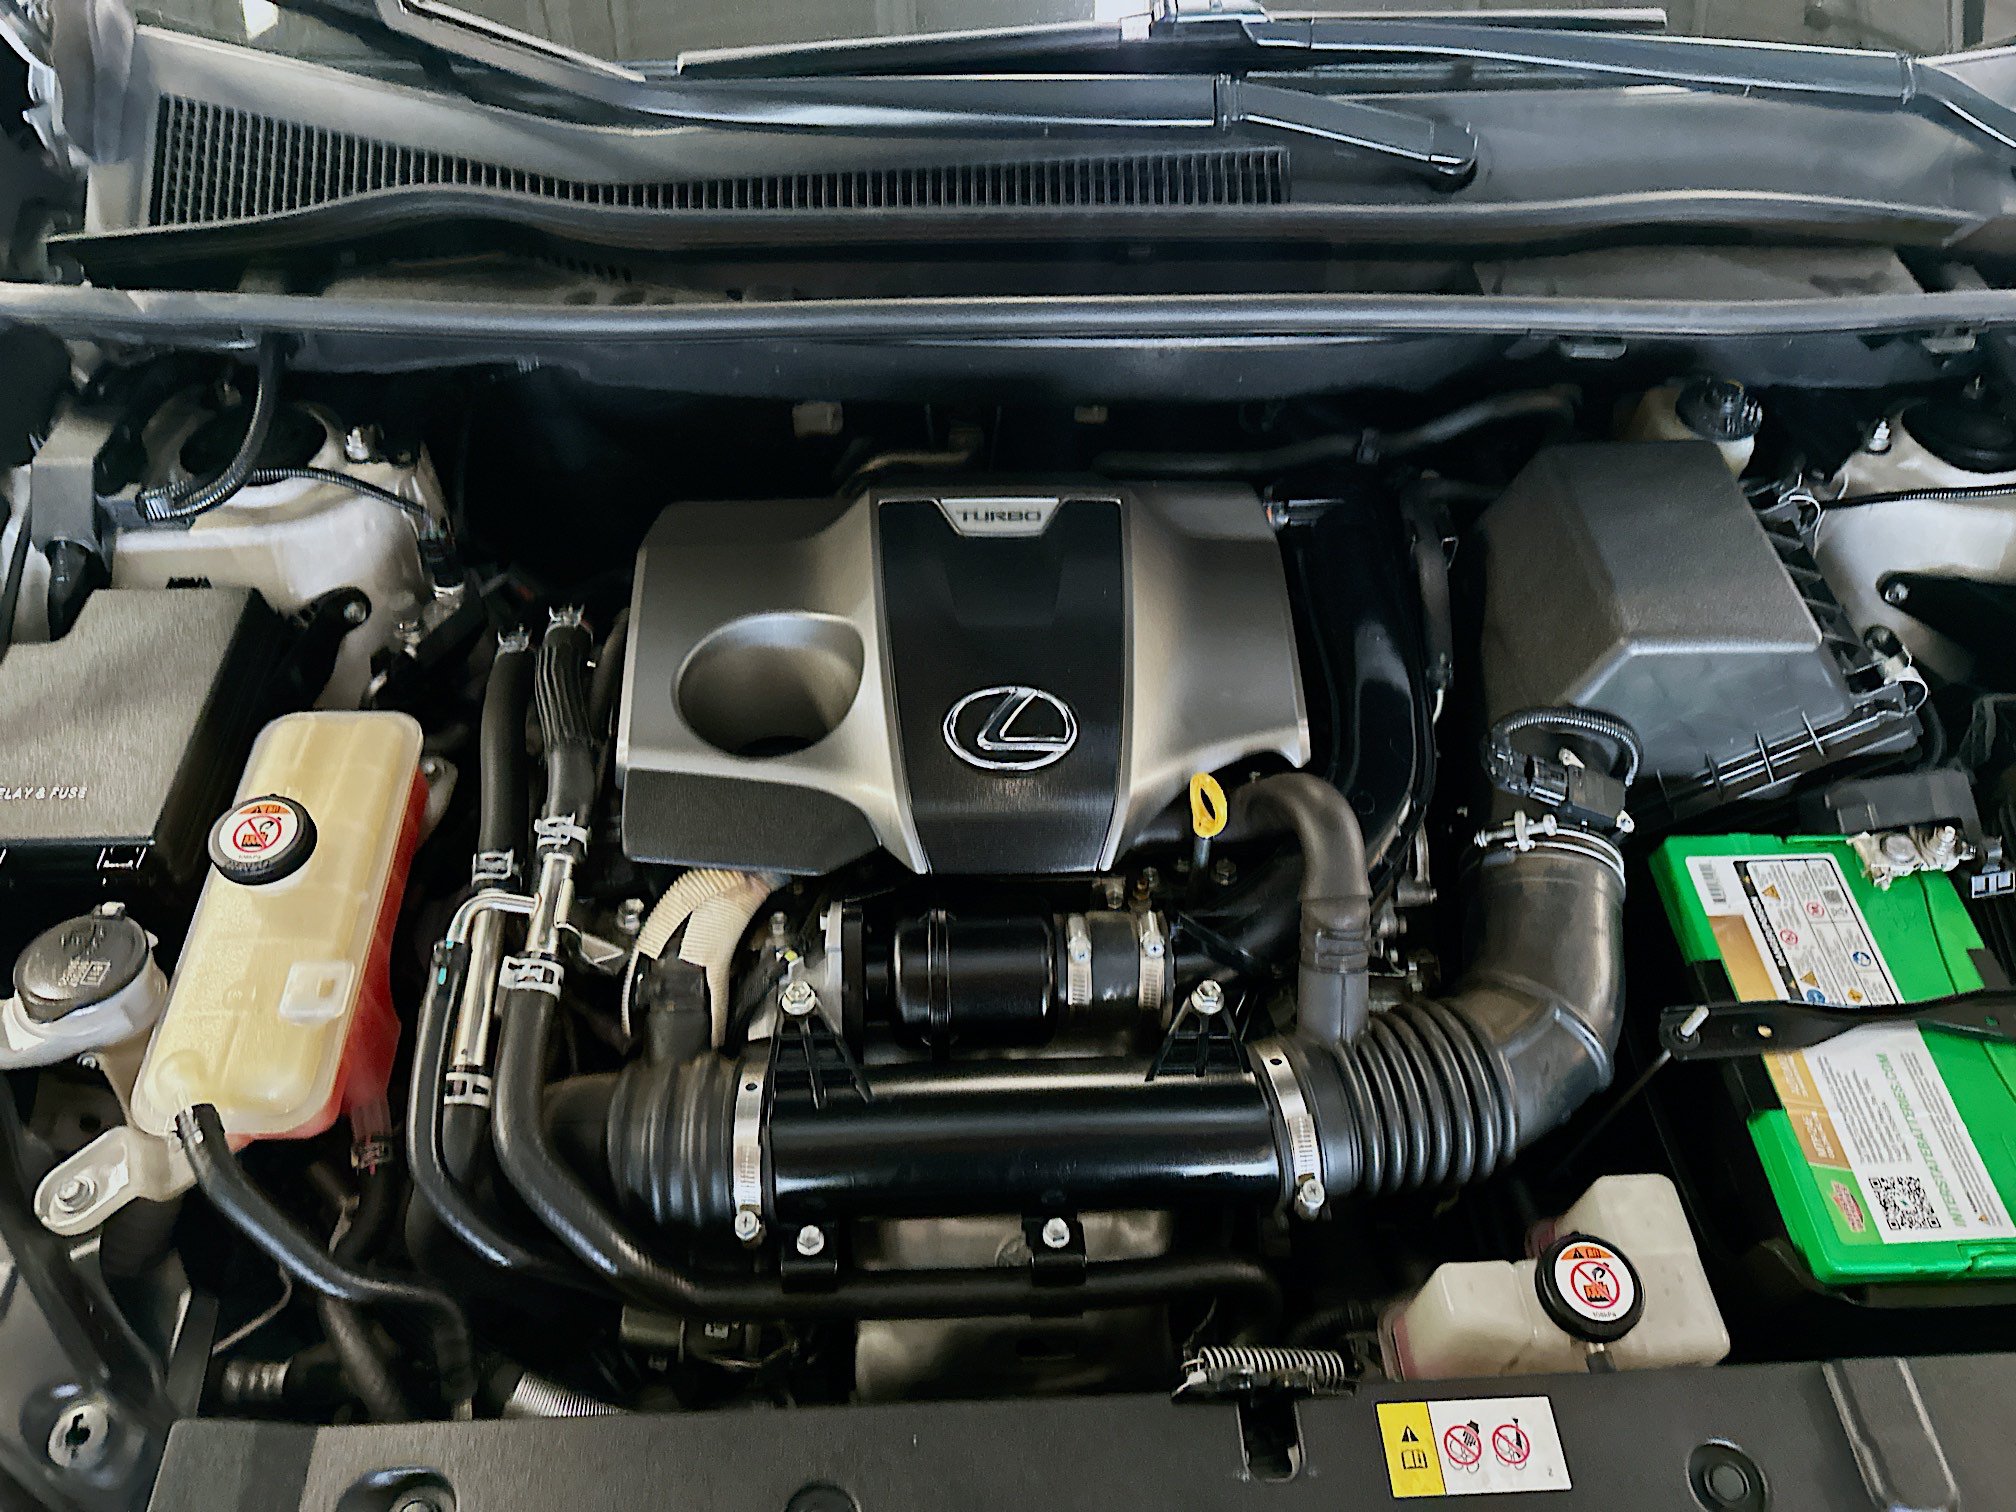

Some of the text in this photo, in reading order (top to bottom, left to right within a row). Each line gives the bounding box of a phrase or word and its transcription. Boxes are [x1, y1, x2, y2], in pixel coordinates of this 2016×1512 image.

[956, 509, 1042, 522] TURBO
[35, 786, 46, 800] &
[49, 786, 88, 800] FUSE
[1874, 1053, 1967, 1227] INTERSTATEBATTERIES.COM
